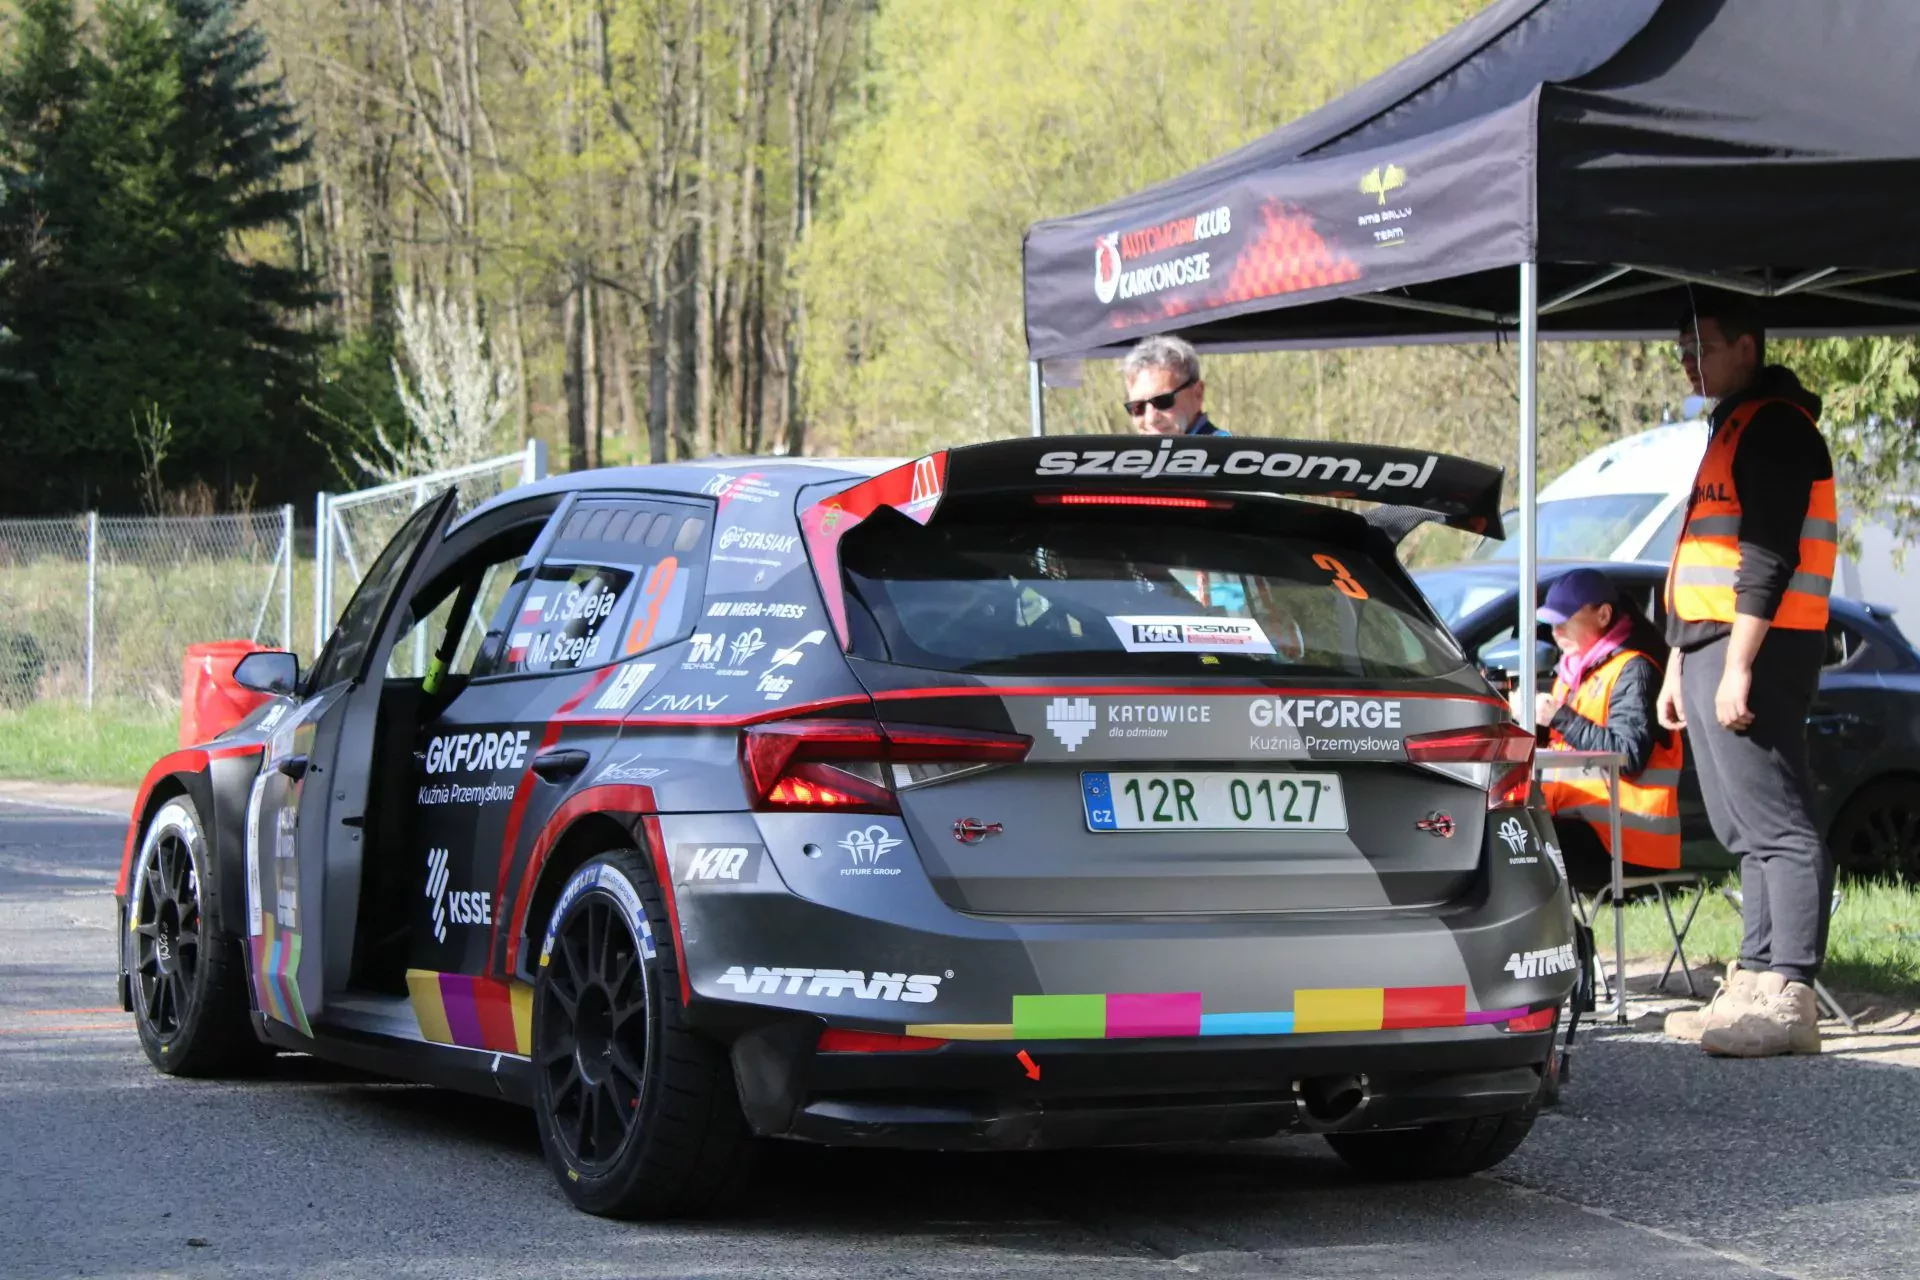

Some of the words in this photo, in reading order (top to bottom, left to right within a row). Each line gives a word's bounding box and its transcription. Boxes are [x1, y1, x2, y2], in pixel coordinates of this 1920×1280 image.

[1121, 206, 1230, 259] AUTOMOBIKLUB
[1120, 252, 1210, 299] KARKONOSZE
[1035, 438, 1435, 490] szeja.com.pl
[739, 531, 798, 553] STASIAK
[1312, 554, 1368, 599] 3
[626, 556, 678, 655] 3
[729, 602, 807, 619] MEGA-PRESS
[1108, 705, 1210, 722] KATOWICE
[1249, 699, 1402, 729] GKFORGE
[1109, 727, 1124, 738] dla
[1125, 727, 1168, 739] odmiany
[1250, 735, 1301, 751] Kuźnia
[1304, 735, 1401, 752] Przemysłowa
[426, 730, 530, 774] GKFORGE
[418, 784, 450, 805] Kuźnia
[450, 781, 515, 807] Przemysłowa
[1125, 778, 1198, 822] 12R
[1230, 778, 1321, 822] 0127
[1092, 810, 1112, 823] CZ
[840, 868, 872, 876] FUTURE
[873, 868, 902, 876] GROUP
[448, 892, 492, 925] KSSE
[551, 868, 598, 931] MICHELIN
